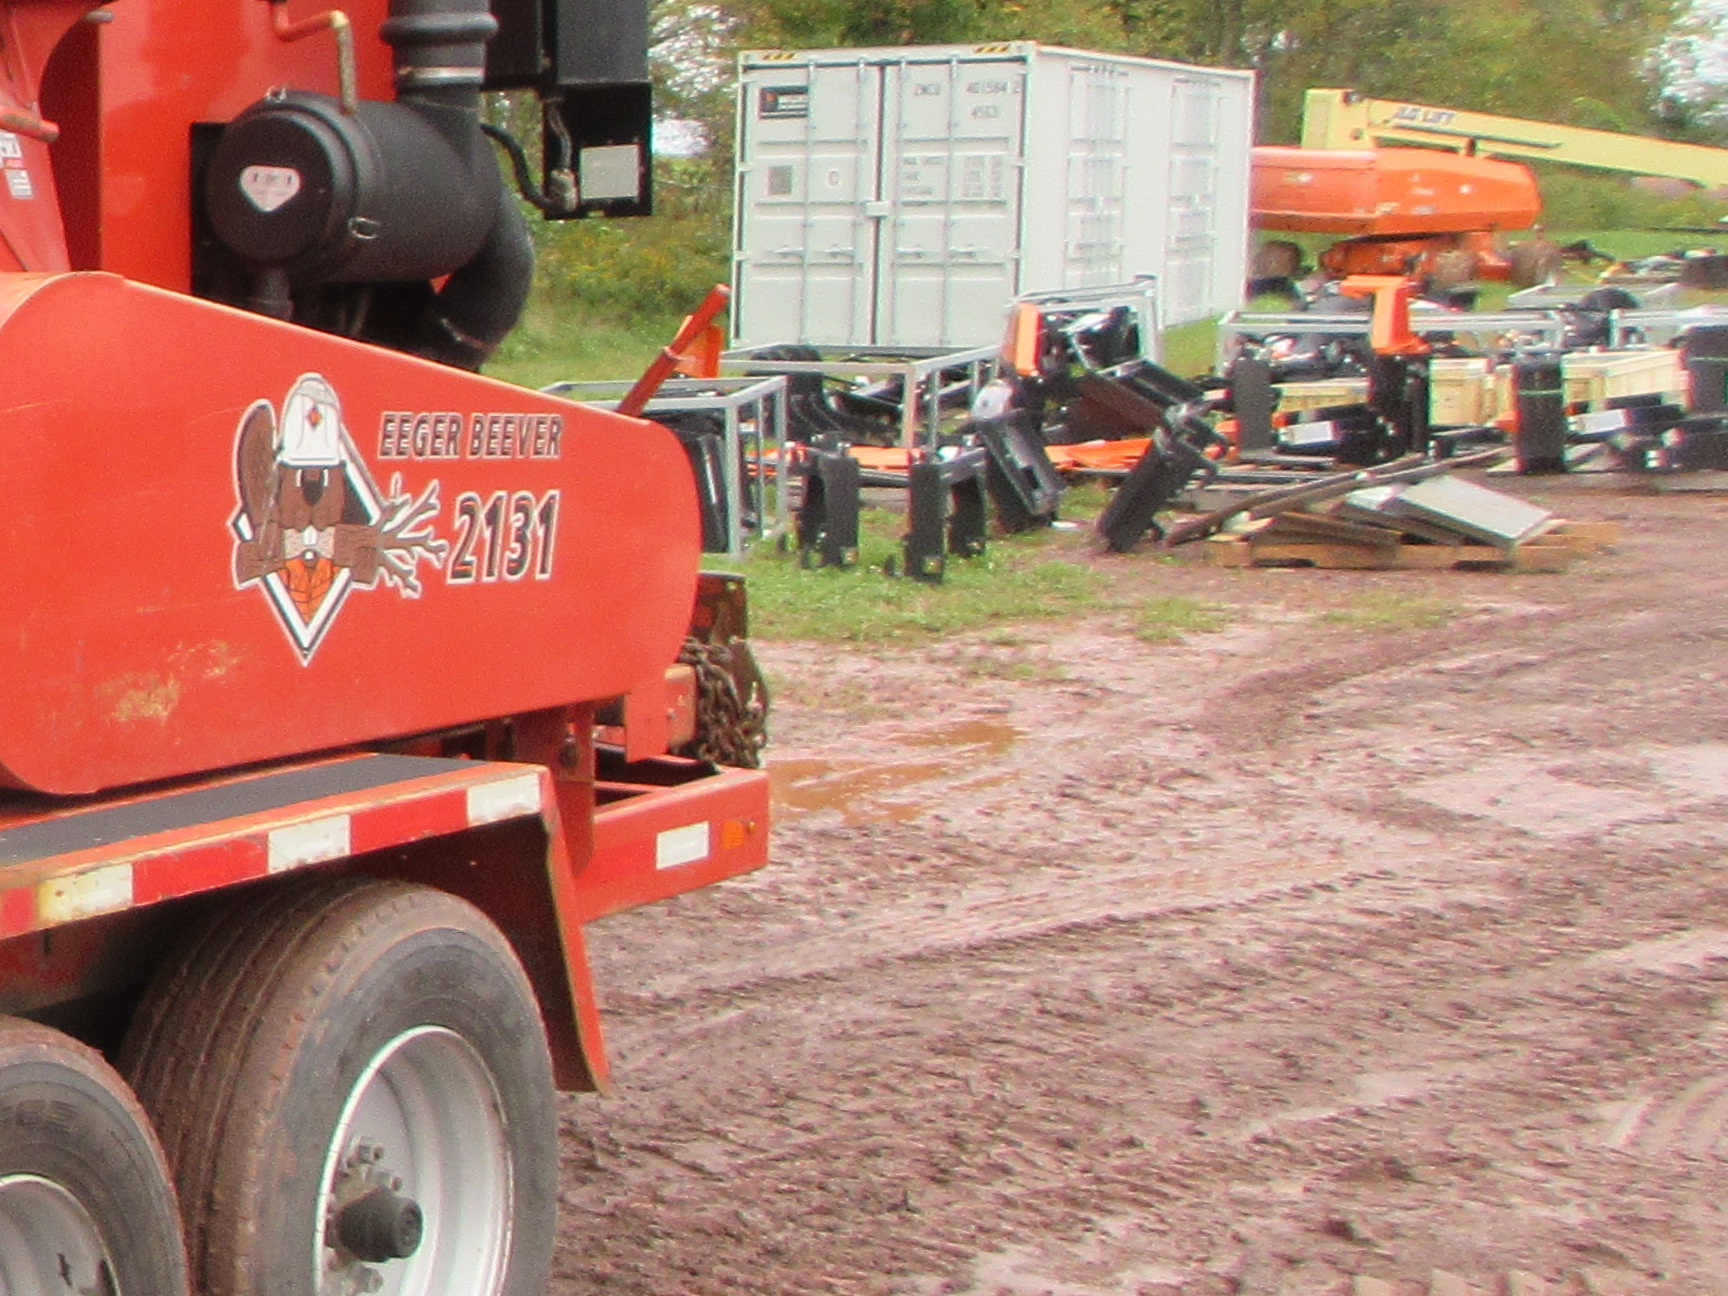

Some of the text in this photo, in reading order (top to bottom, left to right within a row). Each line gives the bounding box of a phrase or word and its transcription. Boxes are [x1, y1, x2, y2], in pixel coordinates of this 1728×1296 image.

[378, 412, 563, 459] EEGER BEEVER
[448, 490, 560, 584] 2131
